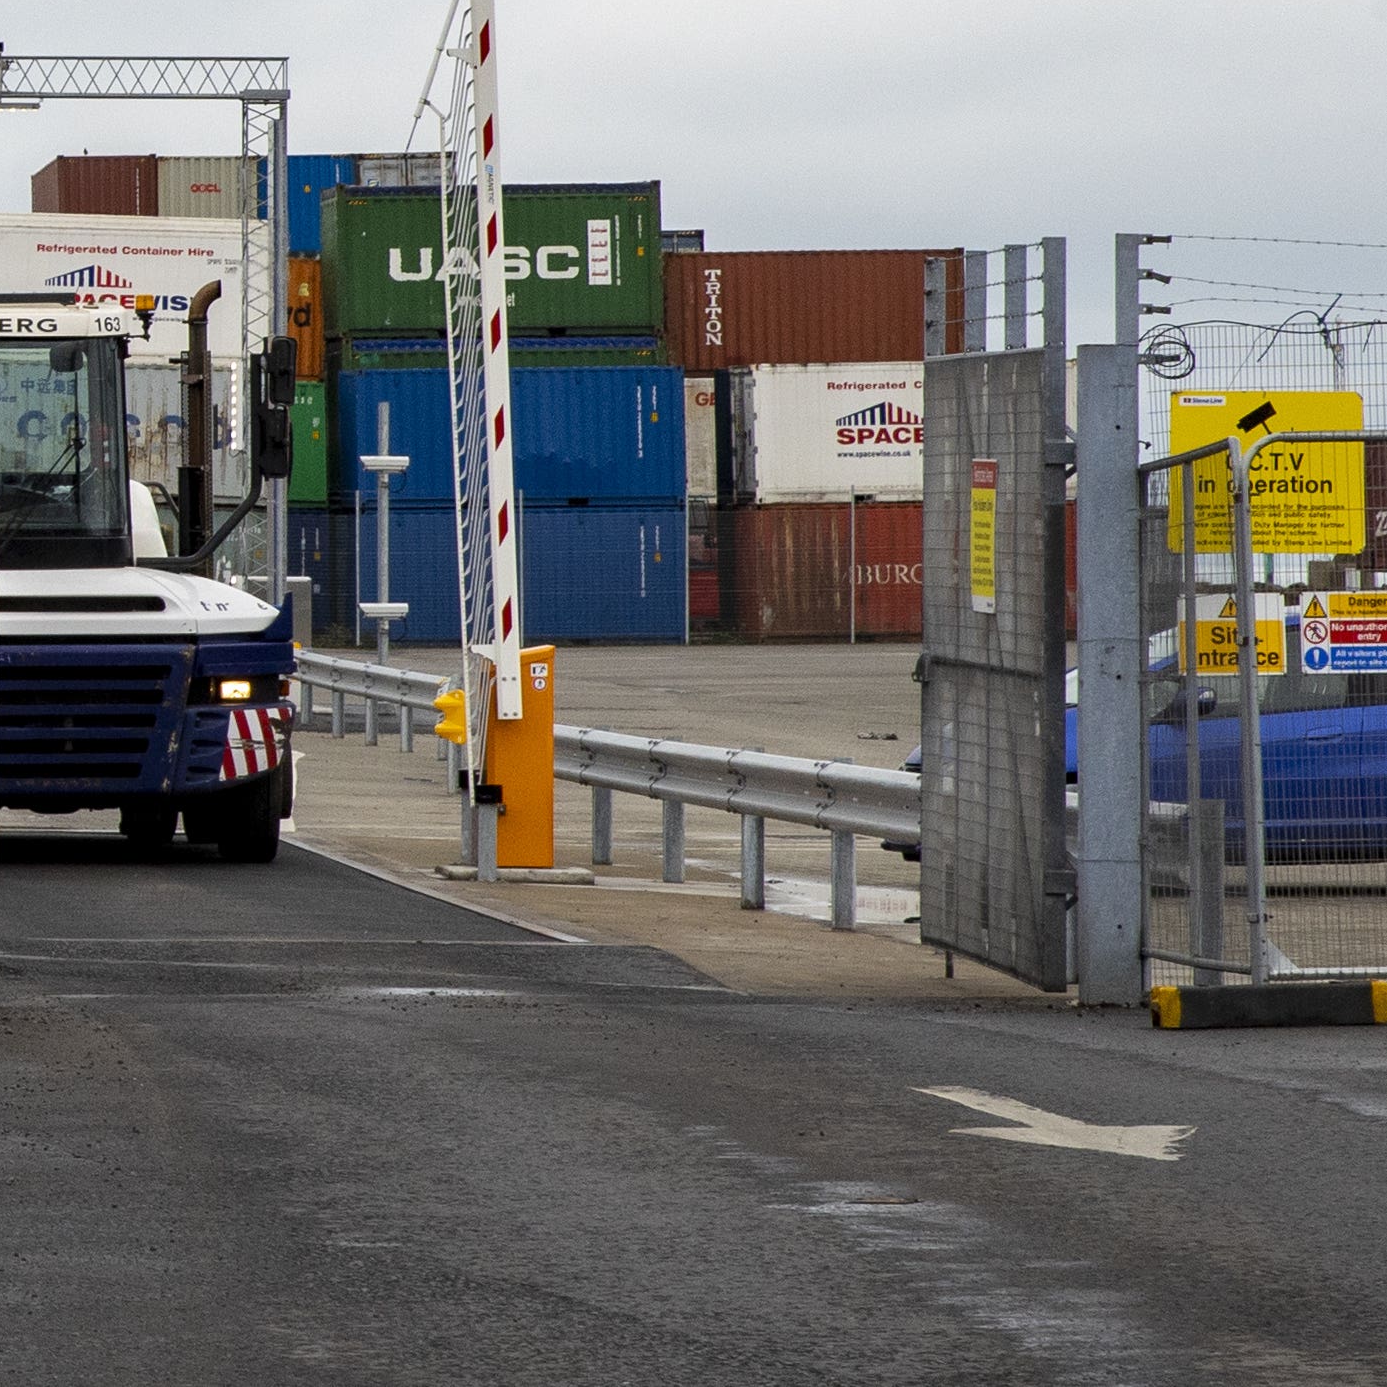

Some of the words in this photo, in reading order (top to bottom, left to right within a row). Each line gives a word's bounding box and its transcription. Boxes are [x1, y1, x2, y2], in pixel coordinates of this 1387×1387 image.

[36, 243, 118, 255] Refrigerated
[122, 245, 184, 256] Container
[187, 247, 215, 257] Hire
[389, 245, 580, 282] UASC
[704, 268, 722, 347] TRITON
[94, 316, 121, 333] 163
[826, 380, 907, 392] Refrigerated
[1198, 475, 1216, 493] in
[1227, 475, 1333, 497] oeration
[1331, 623, 1345, 632] No
[1346, 623, 1387, 632] unauthor
[1211, 626, 1258, 646] Sit
[1357, 633, 1382, 642] entry
[1198, 651, 1280, 667] ntrace
